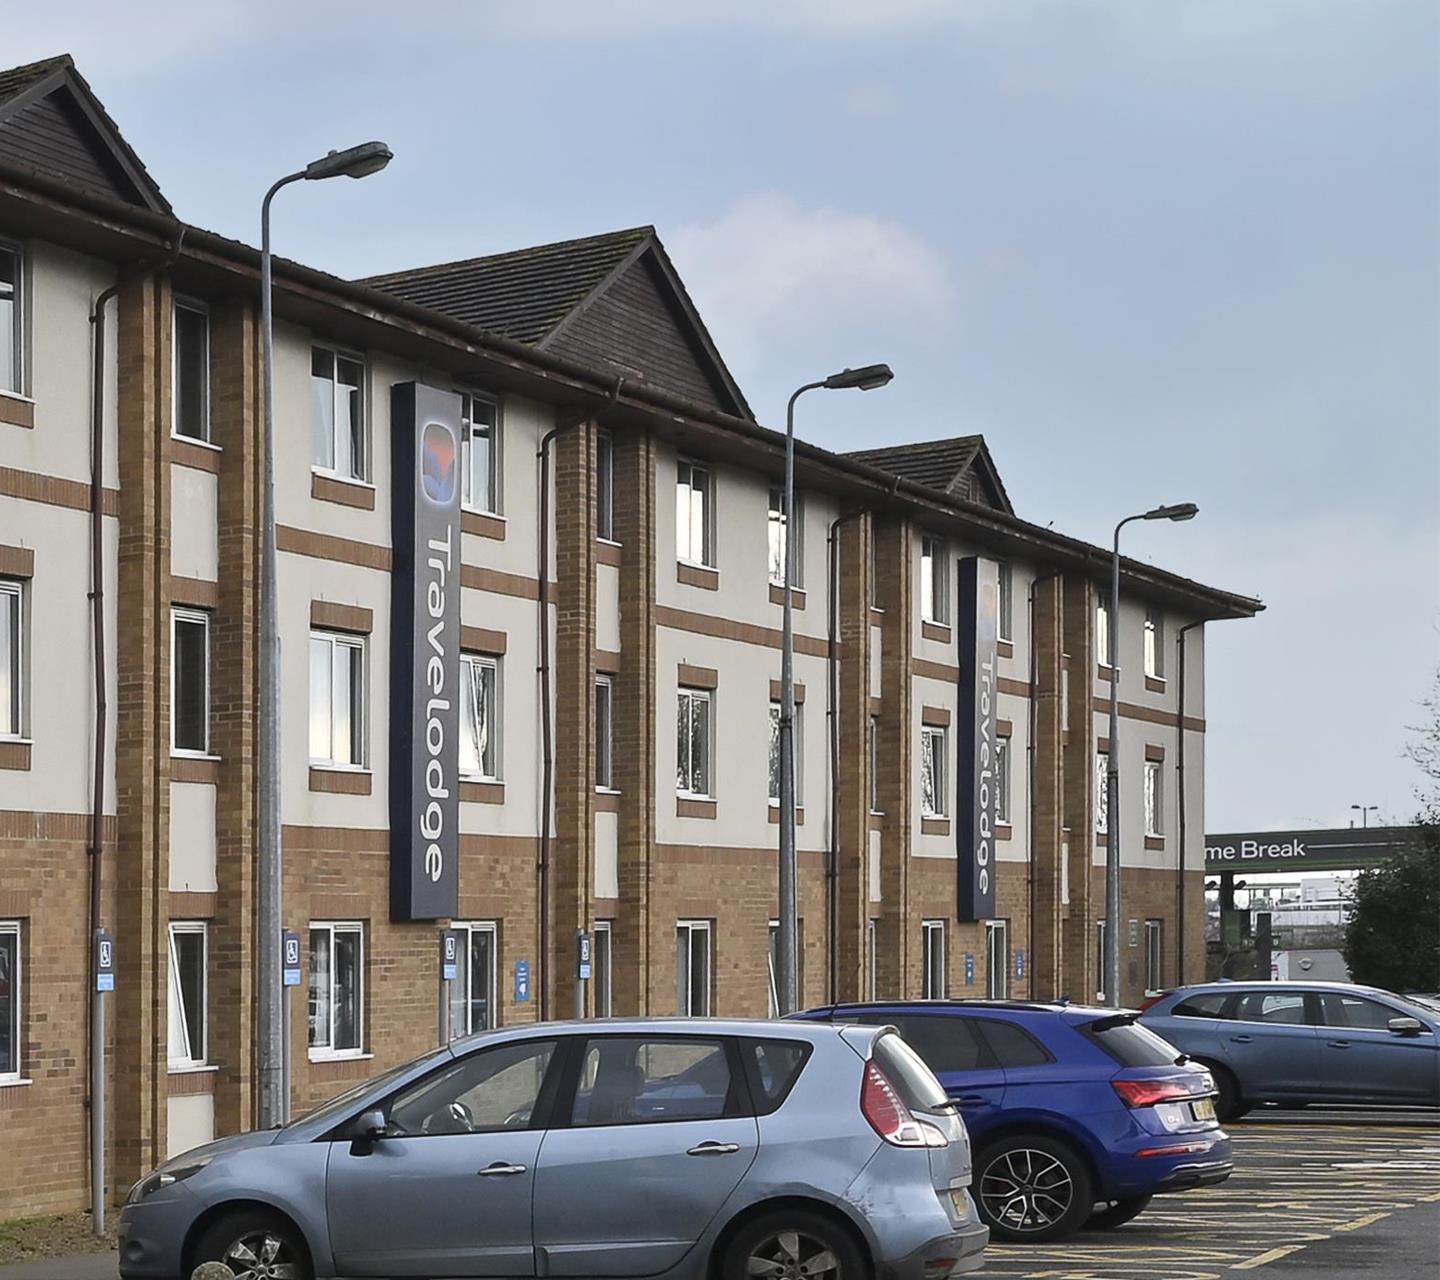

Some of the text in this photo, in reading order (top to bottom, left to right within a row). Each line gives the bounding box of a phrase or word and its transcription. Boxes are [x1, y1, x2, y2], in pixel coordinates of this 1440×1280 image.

[420, 523, 451, 882] Travelodge
[977, 652, 993, 895] Travelodge
[1241, 839, 1306, 859] Break
